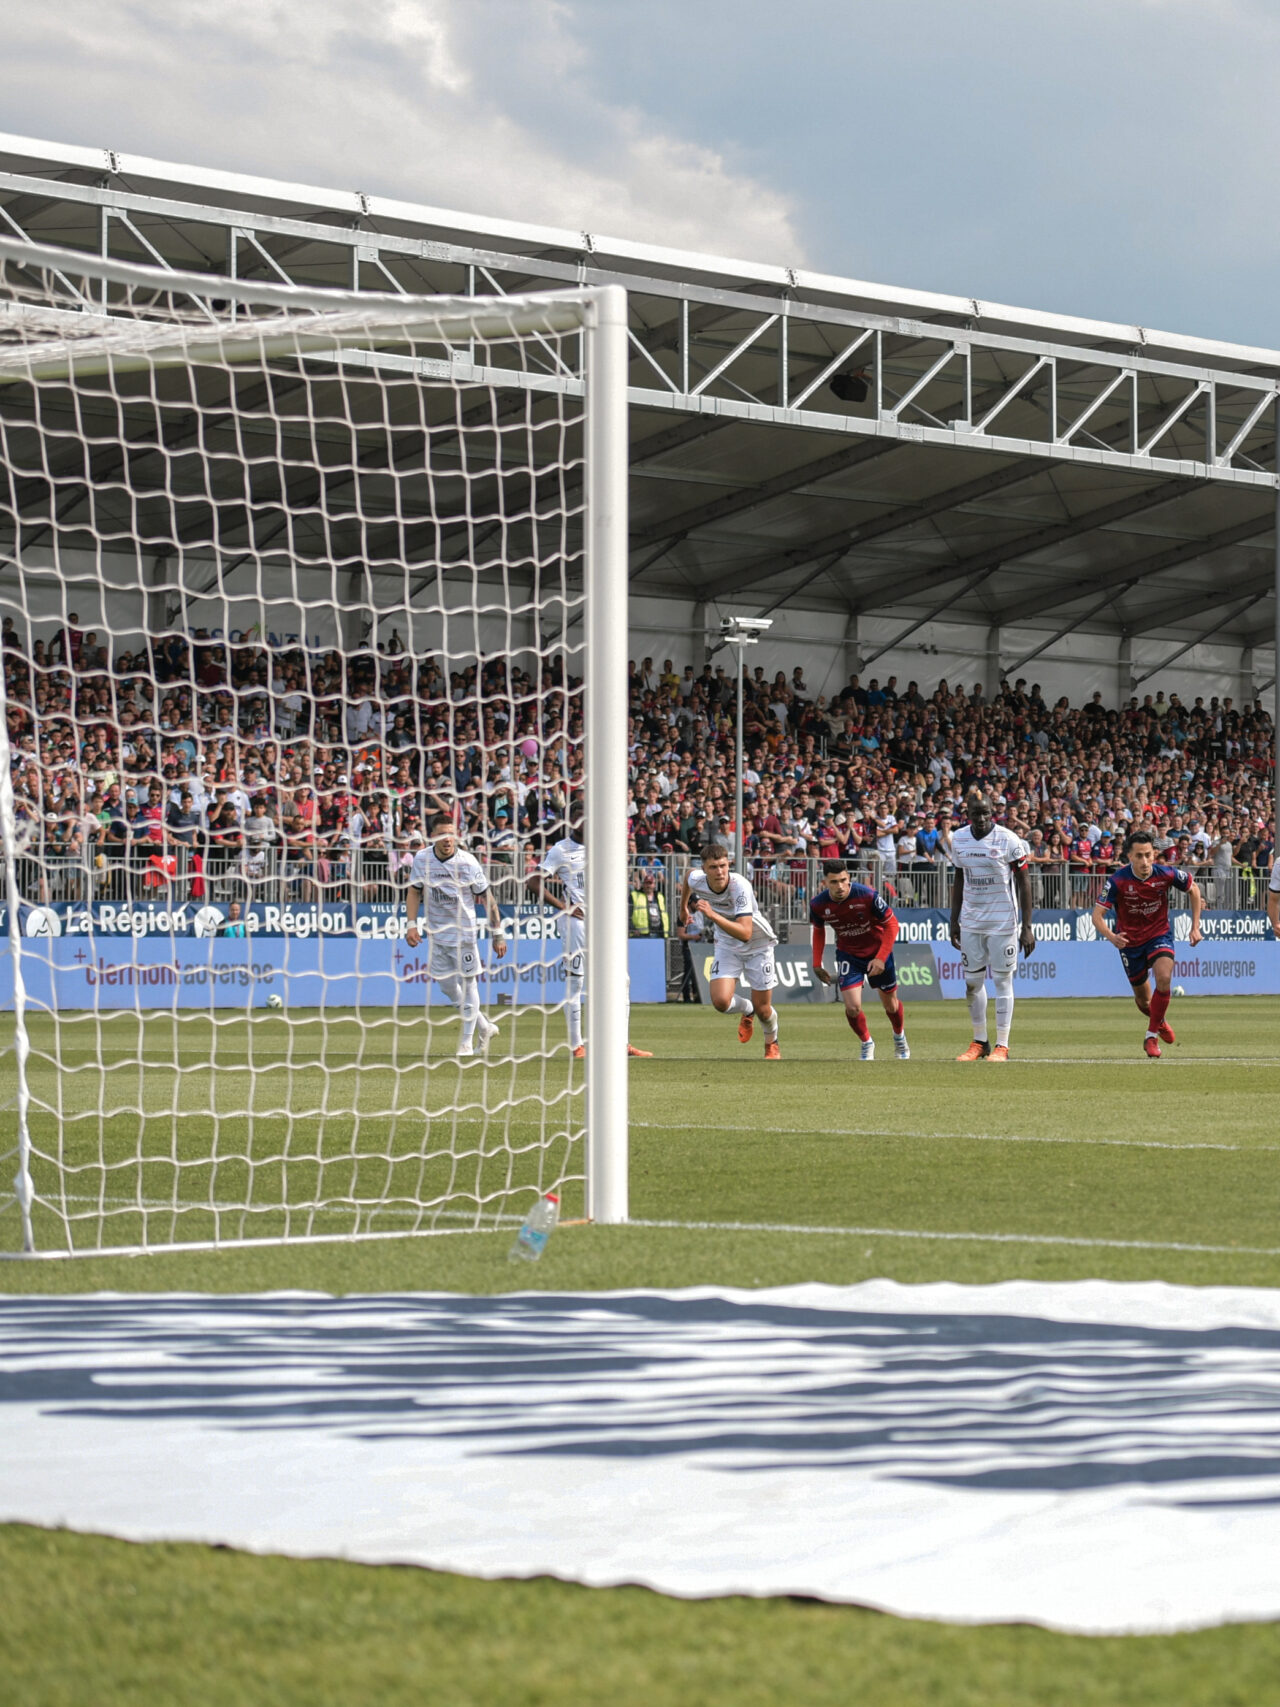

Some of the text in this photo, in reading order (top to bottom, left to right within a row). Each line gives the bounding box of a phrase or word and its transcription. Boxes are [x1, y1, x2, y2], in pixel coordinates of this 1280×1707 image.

[66, 903, 187, 938] La Région
[371, 904, 397, 913] VILLE
[543, 906, 554, 914] DE
[265, 905, 346, 938] Région
[86, 957, 274, 987] clermont auvergne
[1201, 960, 1256, 978] auvergne
